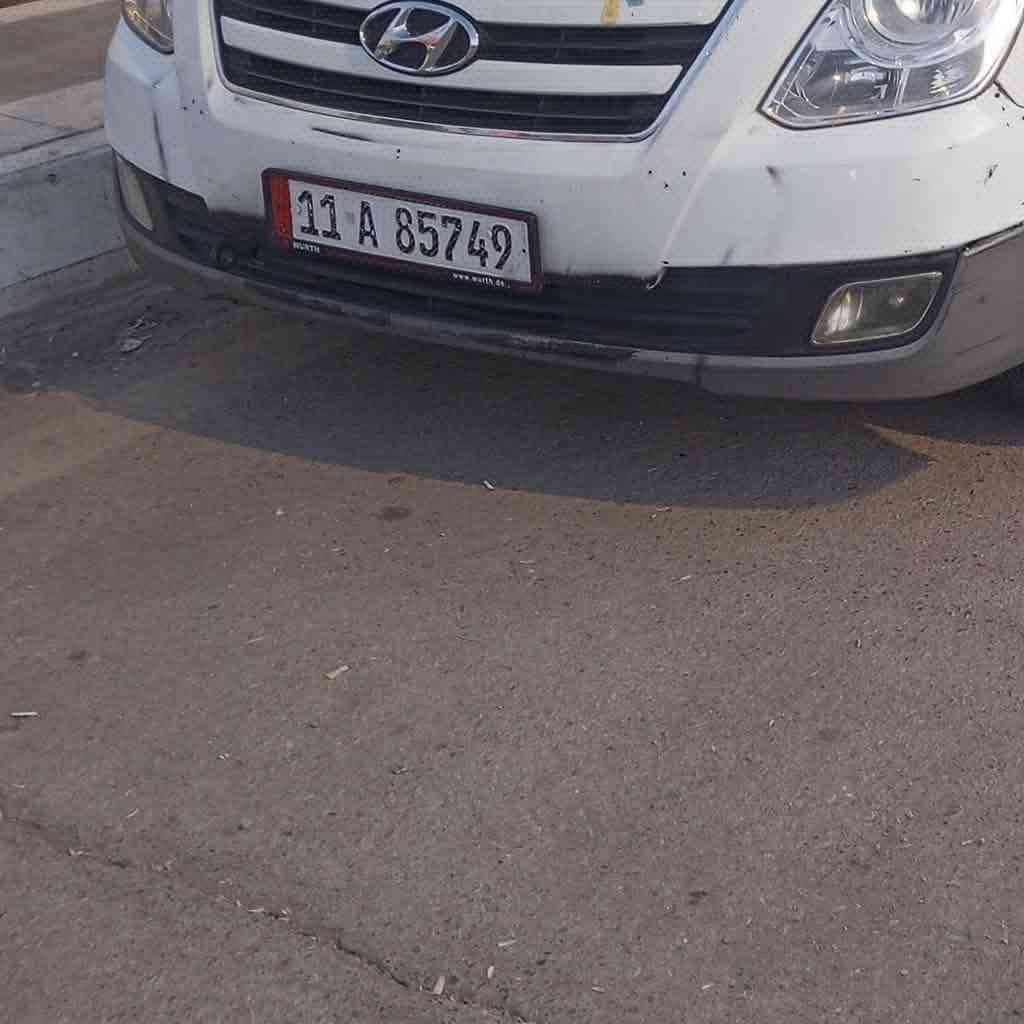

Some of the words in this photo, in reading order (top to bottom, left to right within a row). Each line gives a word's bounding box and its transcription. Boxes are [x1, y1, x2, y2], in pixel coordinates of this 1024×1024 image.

[298, 189, 342, 241] 11
[358, 199, 379, 249] A
[394, 206, 513, 270] 85749
